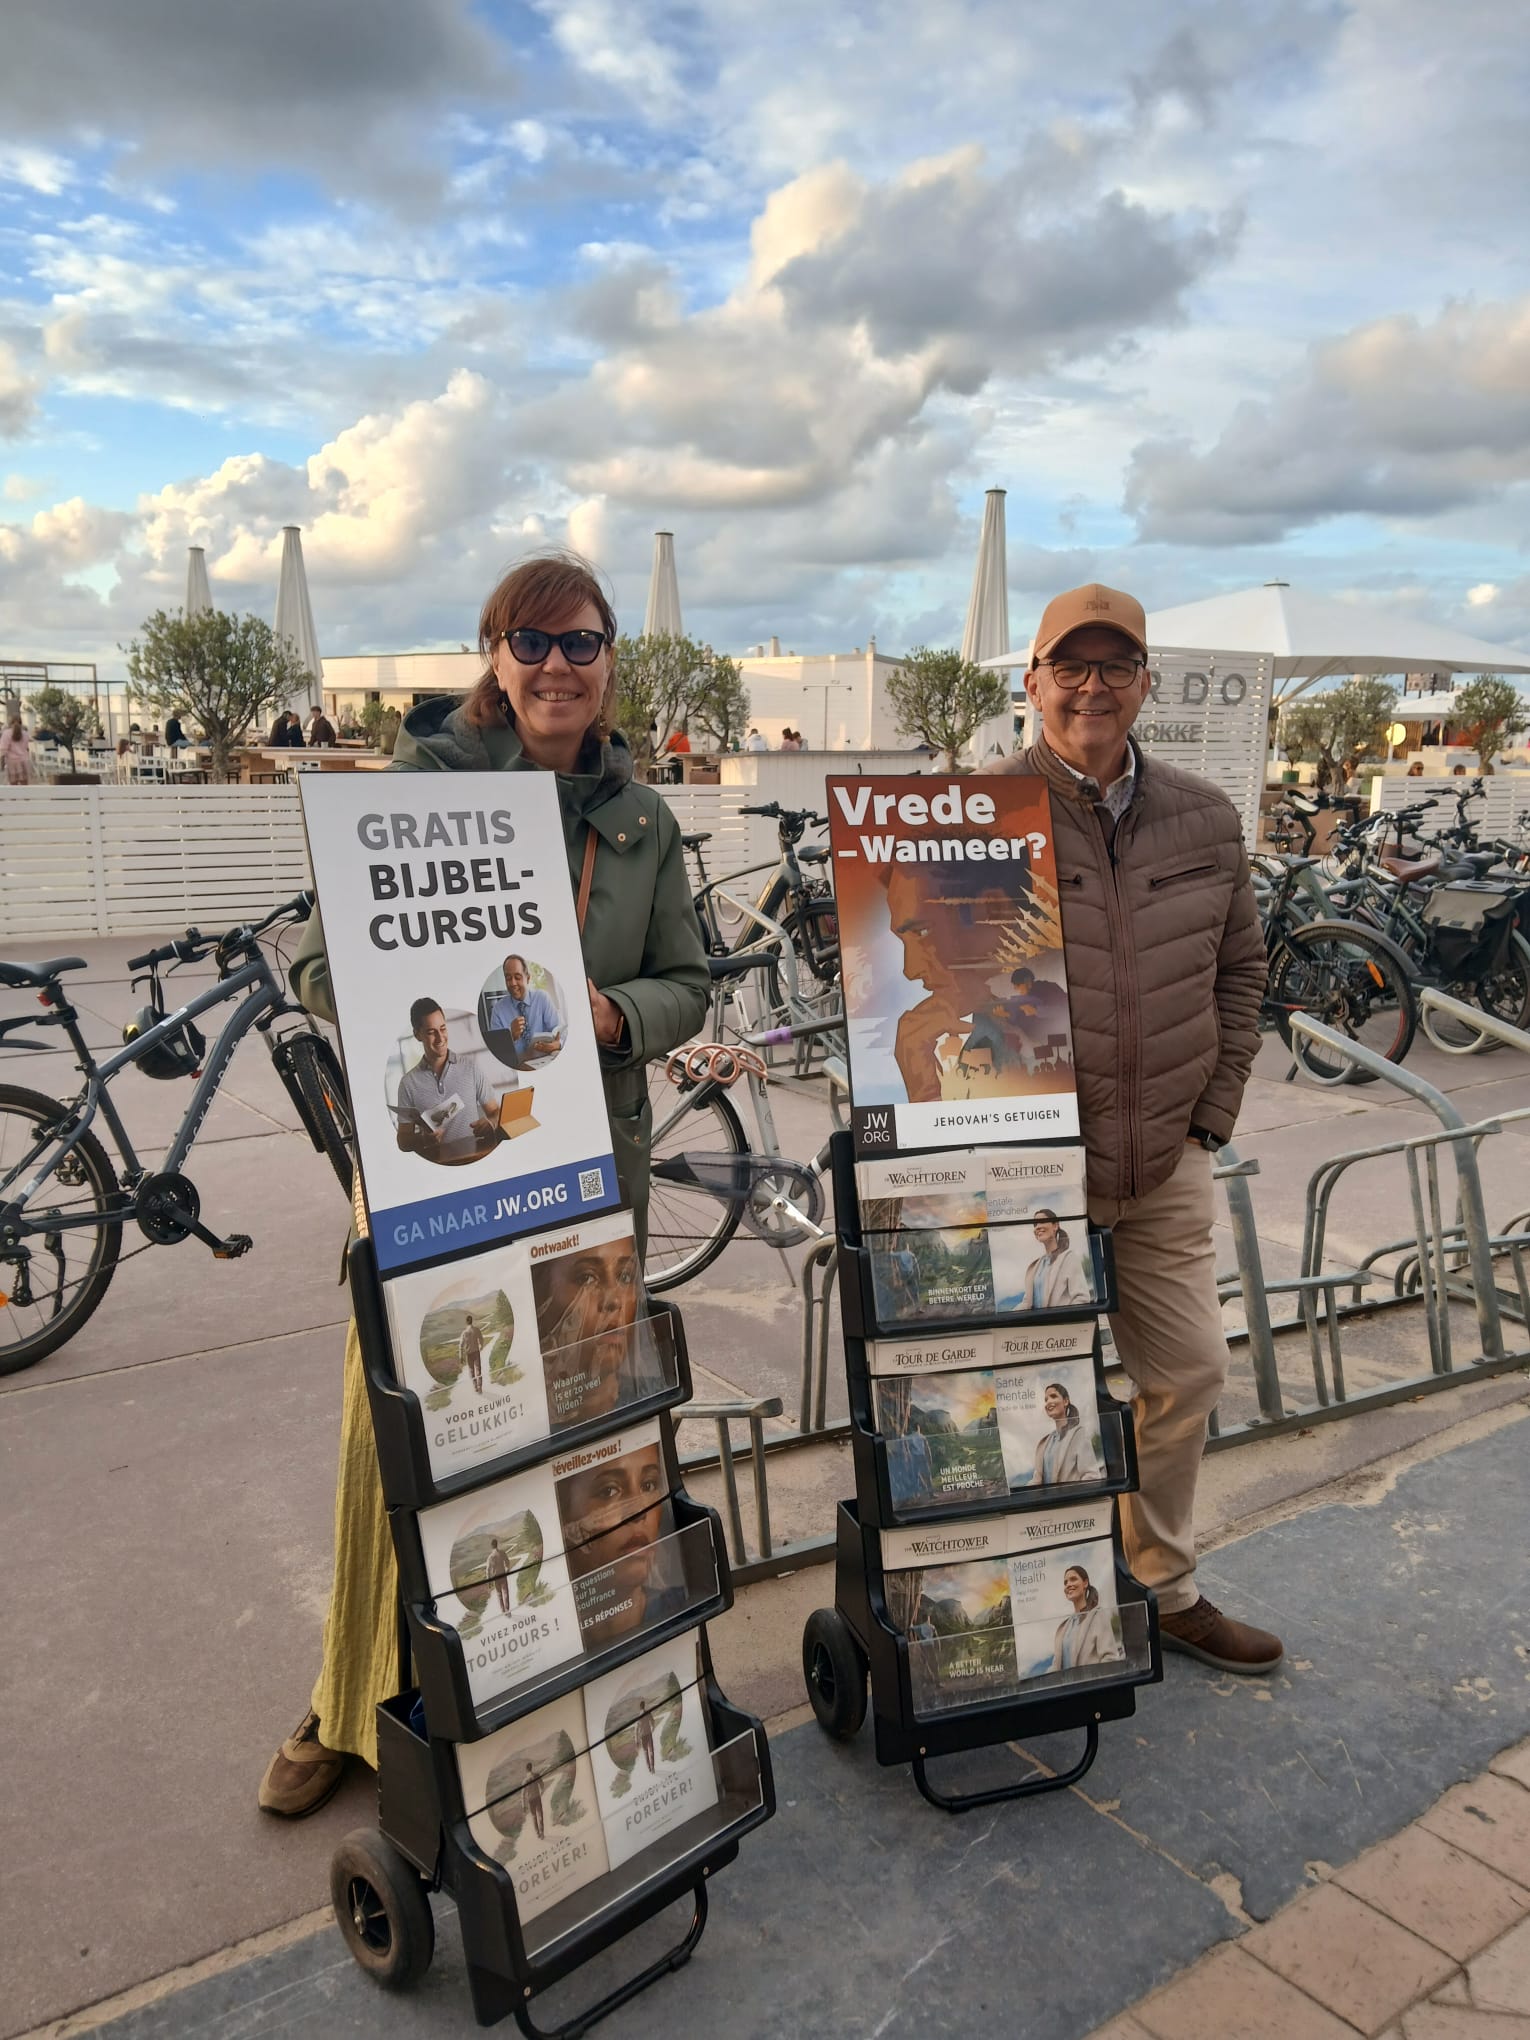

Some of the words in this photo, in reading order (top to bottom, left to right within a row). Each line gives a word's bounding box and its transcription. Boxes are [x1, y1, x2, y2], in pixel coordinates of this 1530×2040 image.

[1130, 723, 1203, 742] NOKKE
[833, 785, 996, 826] Vrede
[357, 810, 516, 851] GRATIS
[368, 857, 535, 900] BIJBEL-
[369, 902, 543, 951] CURSUS
[863, 1112, 888, 1130] JW
[933, 1112, 1000, 1127] JEHOVAH'S
[1004, 1109, 1060, 1122] GETUIGEN
[861, 1130, 891, 1144] .ORG
[888, 1170, 966, 1186] WACHTTOREN
[991, 1164, 1064, 1179] WACHTTOREN
[393, 1223, 425, 1248] GA
[430, 1205, 488, 1239] NAAR
[493, 1183, 569, 1221] JW.ORG
[530, 1234, 579, 1258] Ontwaakt!
[957, 1293, 985, 1302] WERELD
[1004, 1341, 1029, 1353] TOUR
[1031, 1340, 1044, 1351] DE
[1046, 1337, 1077, 1349] GARDE
[895, 1353, 923, 1366] TOUR
[925, 1352, 939, 1362] DE
[941, 1348, 977, 1361] GARDE
[553, 1372, 586, 1390] Waarom
[585, 1376, 601, 1390] veel
[996, 1376, 1023, 1389] Santé
[997, 1389, 1036, 1400] mentale
[446, 1410, 474, 1425] VOOR
[478, 1395, 511, 1414] EEUWIG
[557, 1395, 583, 1414] lijden?
[434, 1403, 524, 1448] GELUKKIG!
[952, 1464, 976, 1473] MONDE
[941, 1473, 978, 1483] MEILLEUR
[943, 1483, 955, 1492] EST
[957, 1480, 984, 1490] PROCHE
[1026, 1519, 1095, 1537] WATCHTOWER
[911, 1536, 989, 1553] WATCHTOWER
[1013, 1557, 1046, 1570] Mental
[573, 1584, 578, 1592] 5
[580, 1568, 615, 1589] questions
[1015, 1571, 1046, 1586] Health
[480, 1627, 509, 1647] VIVEZ
[512, 1615, 536, 1632] POUR
[580, 1617, 594, 1630] LES
[466, 1623, 550, 1672] TOUJOURS
[625, 1778, 693, 1832] FOREVER!
[514, 1842, 588, 1894] OREVER!
